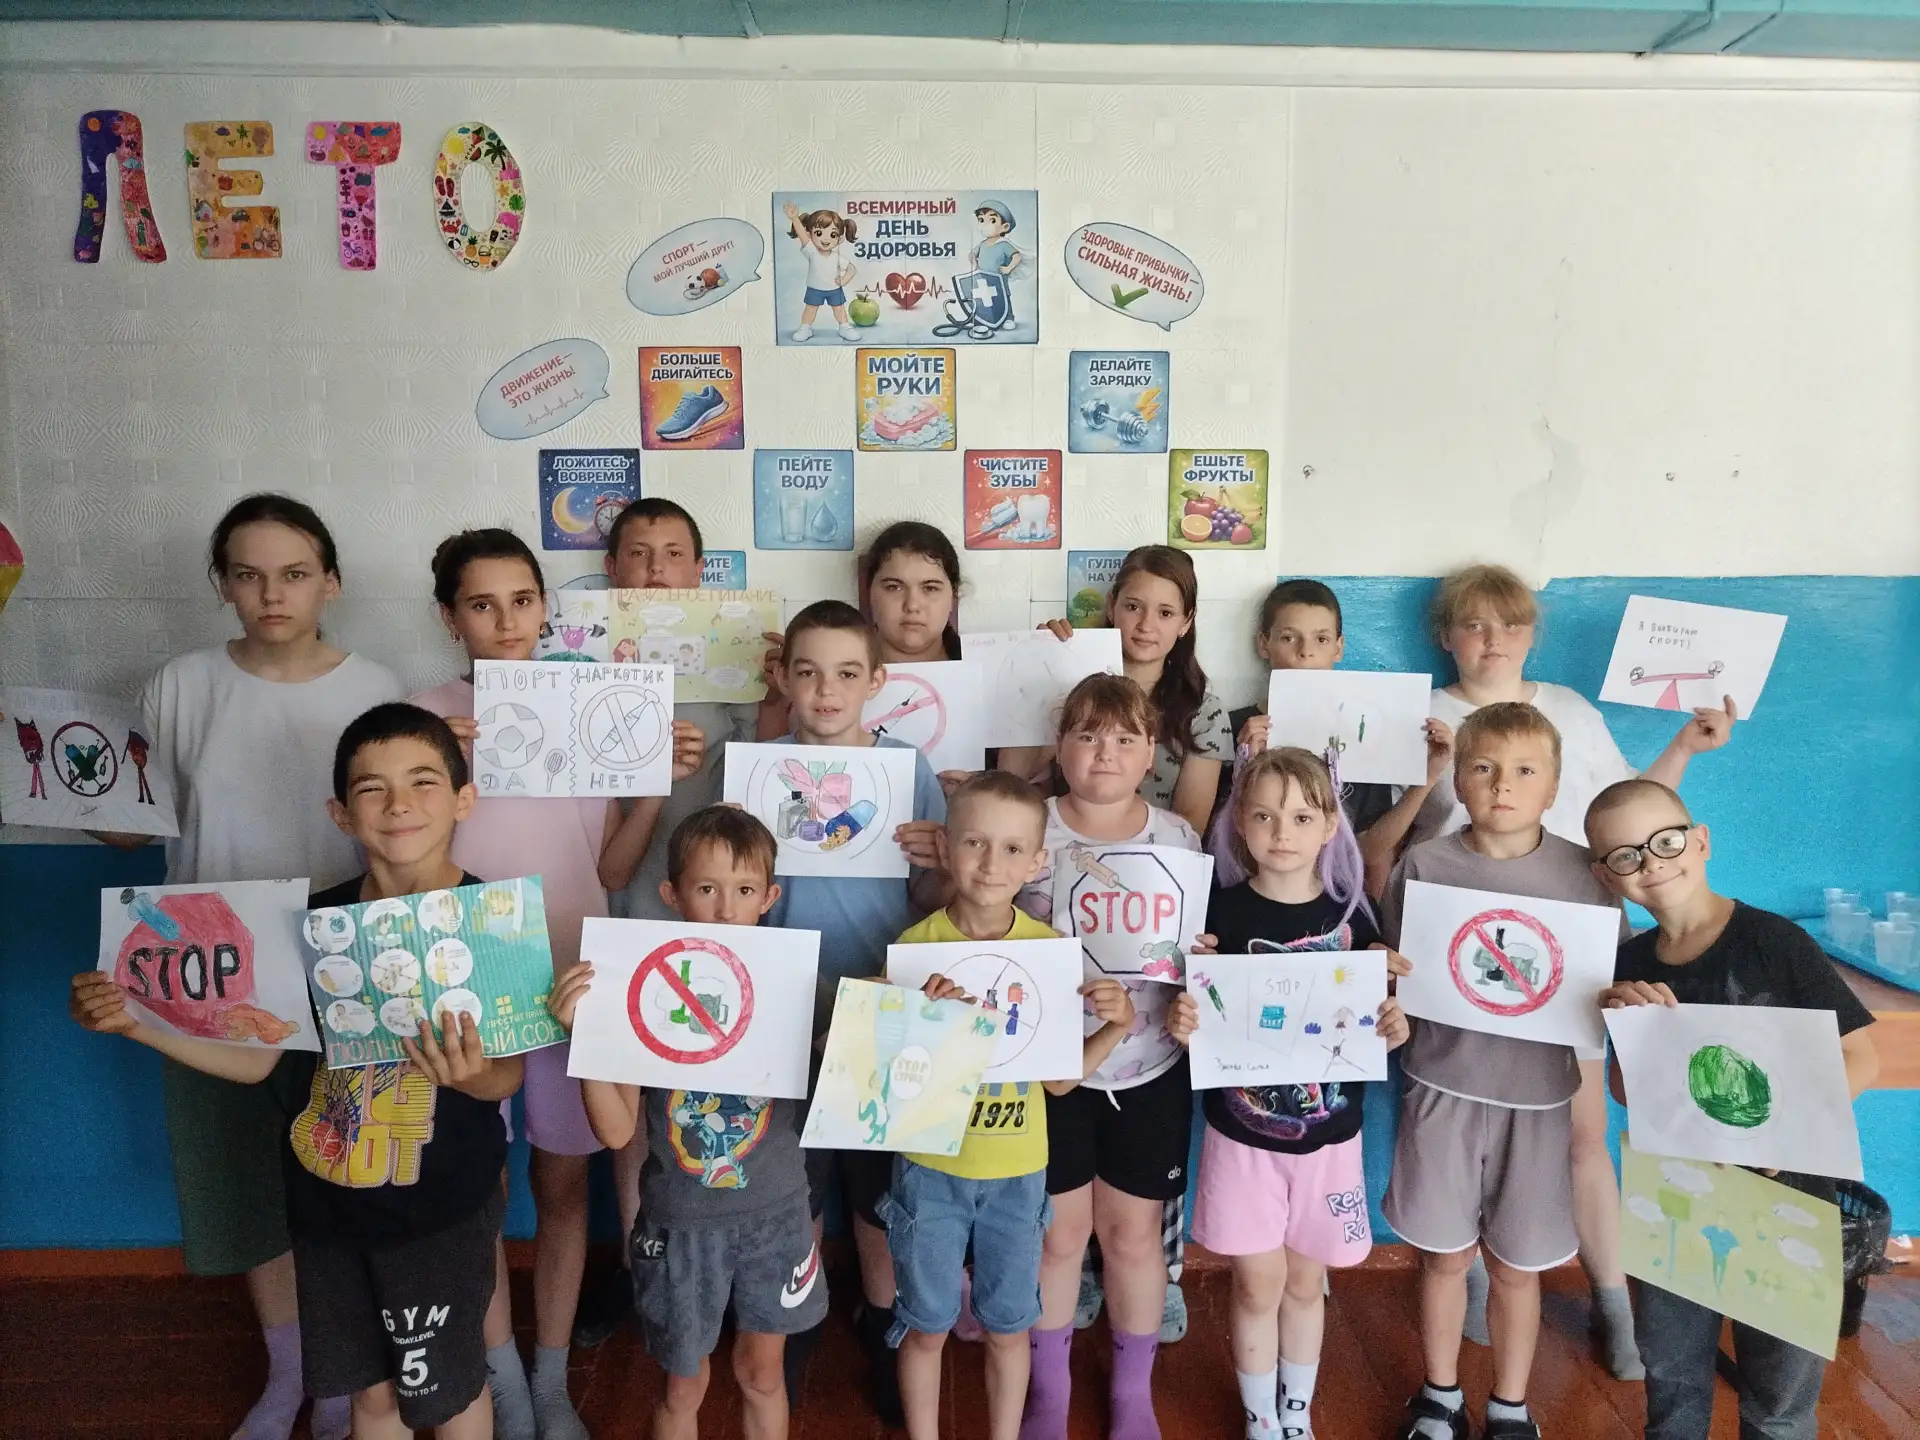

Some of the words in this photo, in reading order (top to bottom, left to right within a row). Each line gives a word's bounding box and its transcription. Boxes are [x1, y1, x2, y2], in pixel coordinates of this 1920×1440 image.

[74, 109, 527, 271] ЛЕТО
[847, 197, 956, 214] ВСЕМИРНЫЙ
[876, 220, 929, 238] ДЕНЬ
[854, 242, 956, 259] ЗДОРОВЬЯ
[1080, 229, 1135, 260] ЗДОРОВЫЕ
[653, 267, 673, 283] МОЙ
[674, 250, 710, 275] ЛУЧШИЙ
[710, 240, 735, 258] ДРУГ!
[1077, 246, 1138, 280] СИЛЬНАЯ
[1138, 271, 1192, 303] ЖИЗНЬ!
[660, 353, 721, 365] БОЛЬШЕ
[869, 353, 945, 374] МОЙТЕ
[1089, 358, 1152, 372] ДЕЛАЙТЕ
[651, 366, 733, 380] ДВИГАЙТЕСЬ
[1090, 375, 1152, 387] ЗАРЯДКУ
[508, 391, 531, 409] ЭТО
[532, 365, 576, 396] ЖИЗНЬ!
[877, 377, 941, 395] РУКИ
[554, 457, 628, 468] ЛОЖИТЕСЬ
[778, 456, 832, 472] ПЕЙТЕ
[980, 459, 1047, 471] ЧИСТИТЕ
[1194, 456, 1245, 467] ЕШЬТЕ
[560, 471, 625, 482] ВОВРЕМЯ
[781, 475, 829, 490] ВОДУ
[990, 474, 1037, 487] ЗУБЫ
[1184, 470, 1254, 482] ФРУКТЫ
[703, 557, 731, 569] ИТЕ
[1088, 558, 1122, 569] ГУЛЯ
[1088, 573, 1105, 582] НА
[1637, 621, 1644, 631] Я
[475, 669, 561, 691] СПОРТ
[575, 665, 665, 684] НАРКОТИК
[481, 771, 526, 791] ДА
[590, 773, 636, 789] НЕТ
[1079, 890, 1176, 934] STOP
[128, 944, 241, 1001] STOP
[970, 1101, 1025, 1128] 1978
[1326, 1185, 1364, 1217] Rea
[382, 1305, 450, 1333] GYM
[401, 1348, 428, 1387] 5
